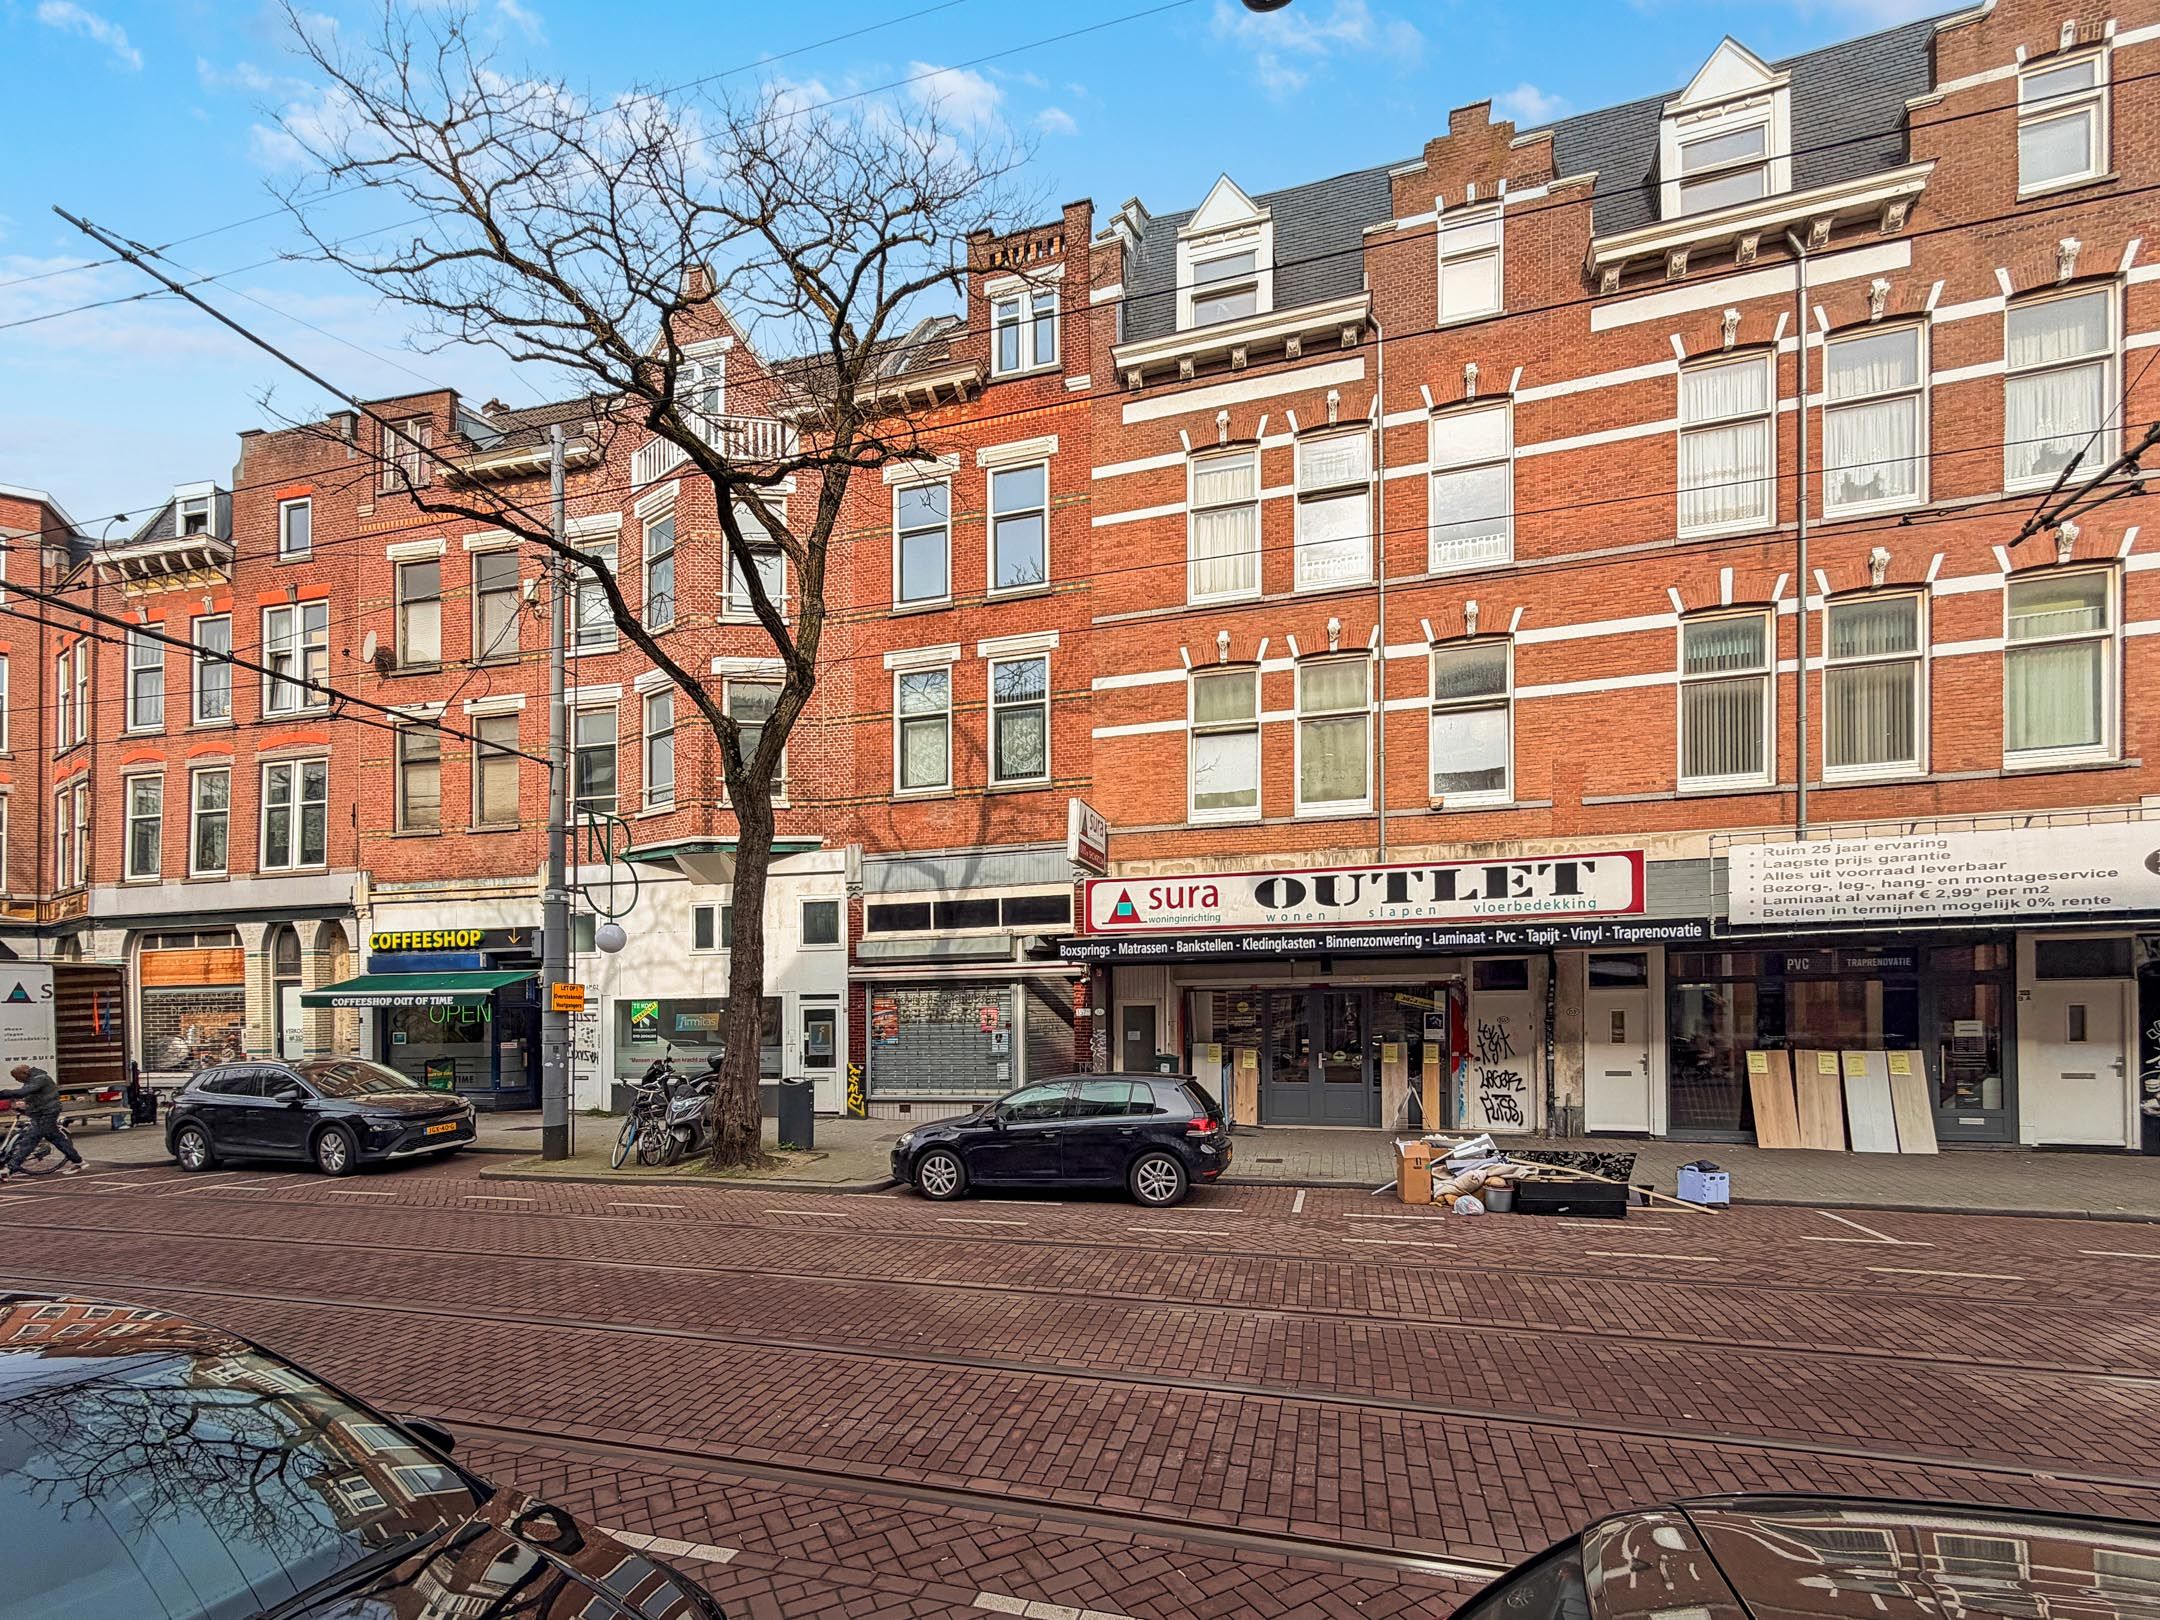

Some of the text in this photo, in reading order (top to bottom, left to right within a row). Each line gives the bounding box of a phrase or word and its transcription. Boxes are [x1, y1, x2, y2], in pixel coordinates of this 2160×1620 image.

[1090, 813, 1104, 837] sura
[1763, 838, 1948, 857] Ruim 25 jaar ervaring
[1763, 851, 1951, 869] Laagste prijs garantie
[1763, 861, 2008, 881] Alles uit voorraad leverbaar
[1763, 868, 2119, 894] Bezorg-, leg-, hang- en montageservice
[1148, 861, 1596, 910] sura OUTLET
[1763, 895, 1841, 906] Laminaat
[1845, 892, 1860, 902] al
[1866, 890, 1915, 901] vanaf
[1919, 889, 1931, 899] €
[1986, 886, 2017, 898] per
[2022, 885, 2050, 895] m2
[1265, 898, 1597, 923] wonen slapen vloerbedekking
[1763, 894, 2112, 918] Betalen in termijnen mogelijk 0% rente
[1148, 913, 1221, 926] woninginrichting
[369, 929, 481, 950] COFFEESHOP
[1060, 944, 1110, 958] Boxsprings
[1118, 941, 1168, 955] Matrassen
[1176, 938, 1233, 952] Bankstellen
[1242, 934, 1316, 951] Kledingkasten
[1326, 930, 1423, 948] Binnenzonwering
[1432, 930, 1486, 945] Laminaat
[1496, 929, 1517, 943] Pvc
[1526, 927, 1560, 944] Tapijt
[1570, 925, 1603, 942] Vinyl
[1612, 923, 1702, 941] Traprenovatie
[1786, 958, 1810, 971] PVC
[1847, 957, 1912, 968] TRAPRENOVATIE
[331, 996, 454, 1007] COFFEESHOP OUT OF TIME
[429, 1004, 492, 1024] OPEN
